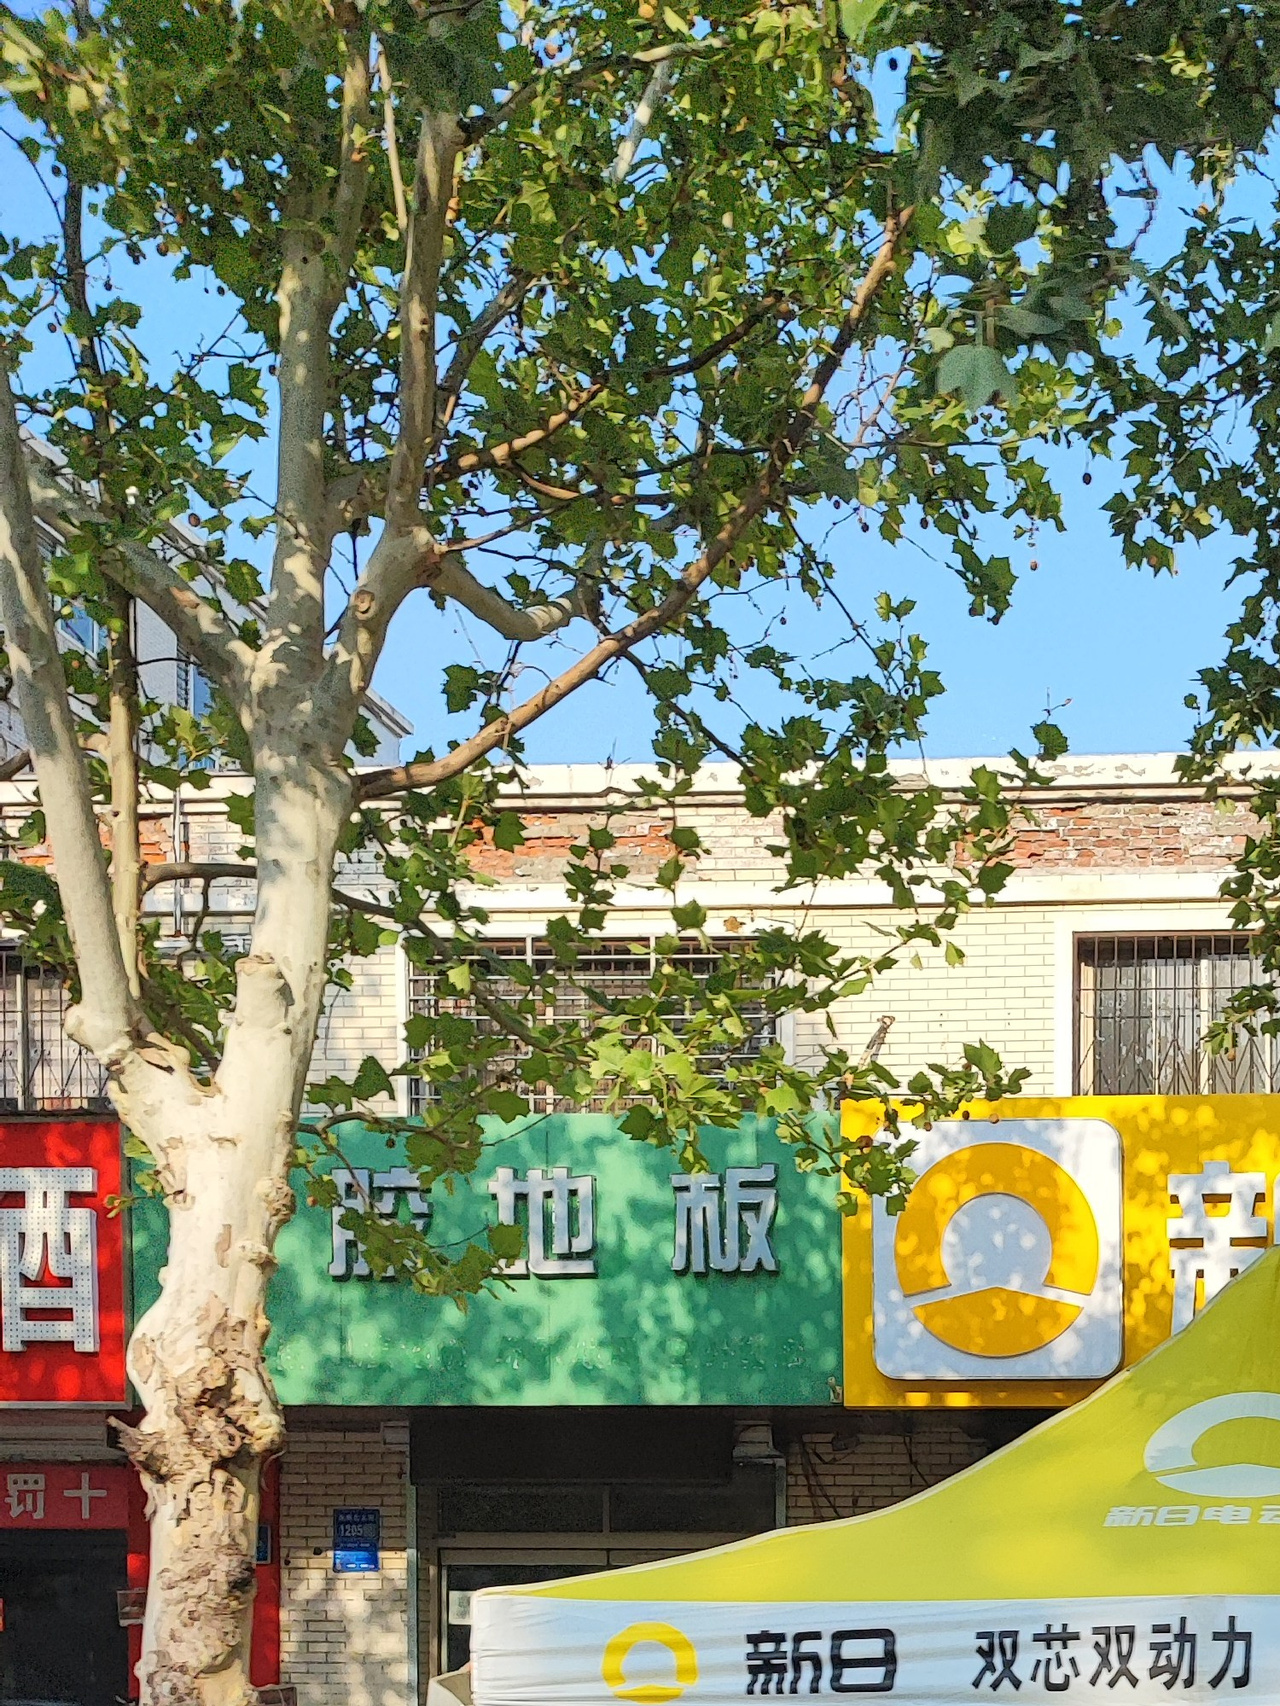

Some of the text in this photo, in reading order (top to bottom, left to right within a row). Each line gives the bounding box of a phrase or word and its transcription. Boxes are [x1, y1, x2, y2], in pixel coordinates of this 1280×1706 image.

[745, 1628, 897, 1695] 新日
[971, 1614, 1254, 1693] 双芯双动力
